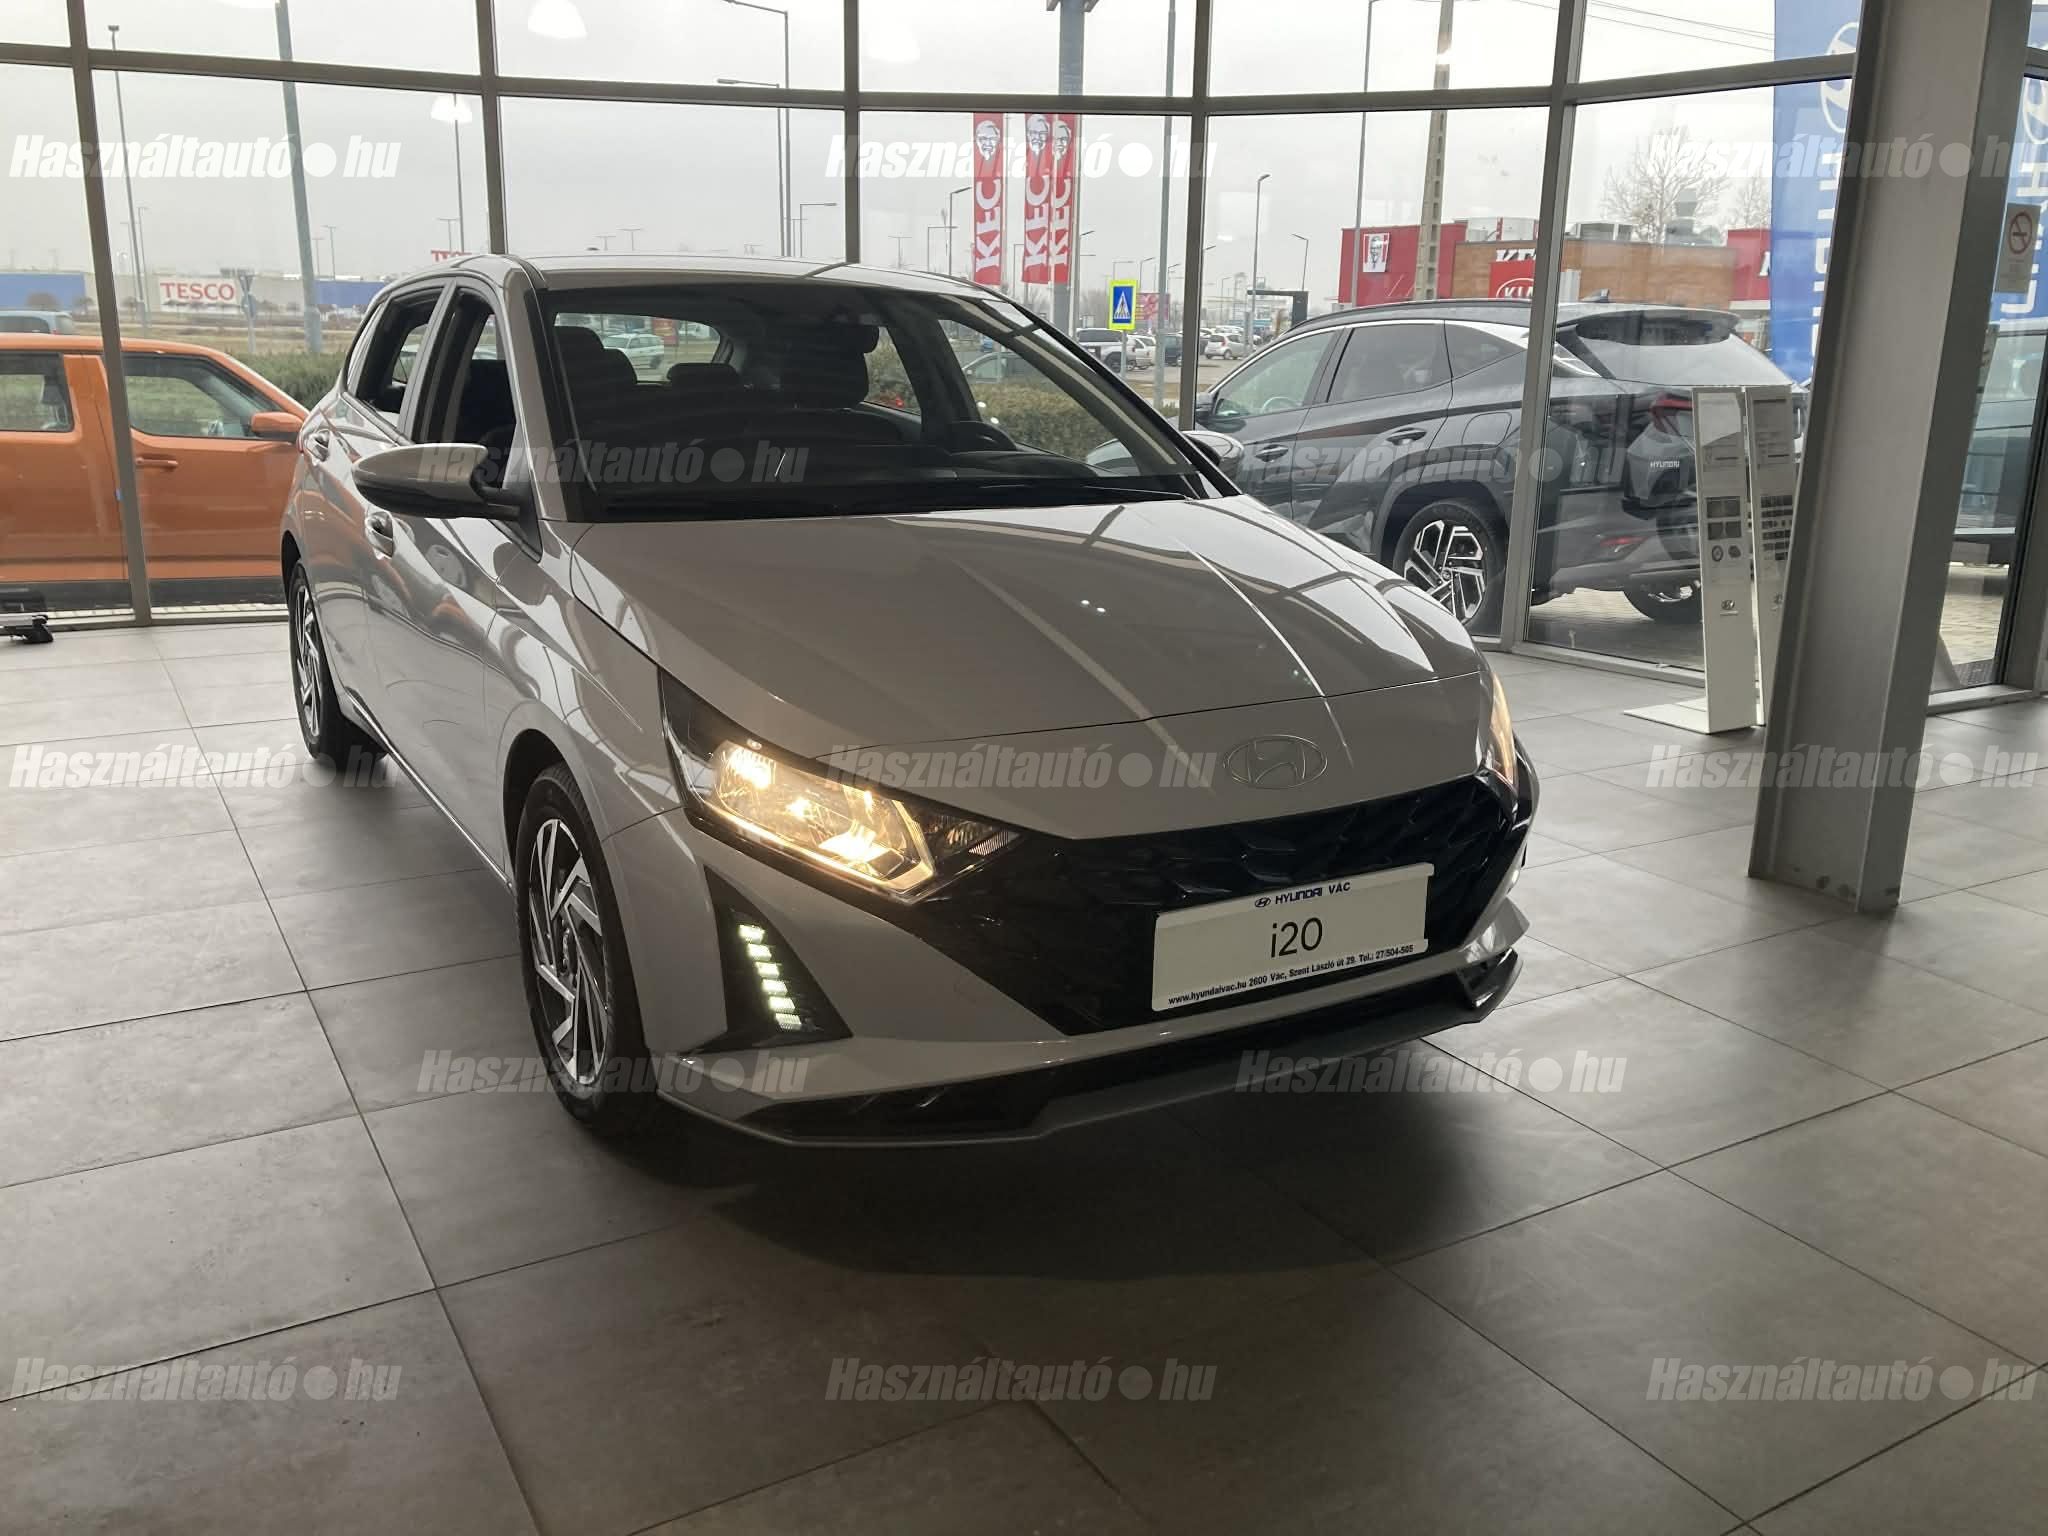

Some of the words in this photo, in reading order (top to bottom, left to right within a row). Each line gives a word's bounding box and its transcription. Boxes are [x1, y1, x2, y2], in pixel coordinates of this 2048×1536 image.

[976, 178, 1001, 273] KFC
[1024, 174, 1050, 269] KFC
[1051, 178, 1072, 266] KFC
[160, 282, 235, 301] TESCO
[1275, 887, 1323, 905] HYUNDAI
[1270, 917, 1323, 958] i20
[1248, 975, 1268, 987] 2600
